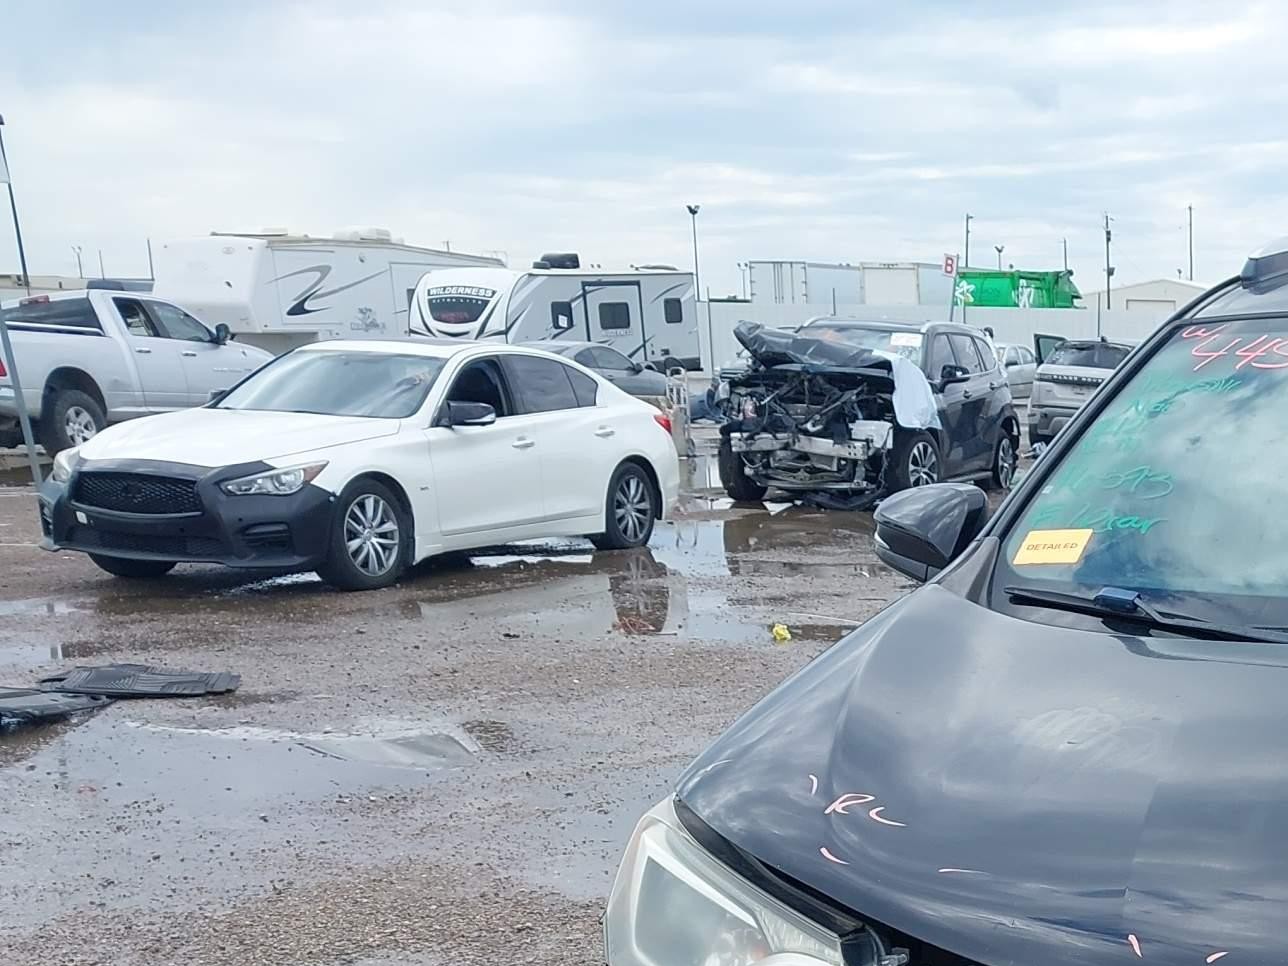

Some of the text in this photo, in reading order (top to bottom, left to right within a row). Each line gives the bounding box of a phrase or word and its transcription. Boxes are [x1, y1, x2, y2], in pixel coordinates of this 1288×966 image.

[944, 256, 954, 274] B
[429, 286, 493, 297] WILDERNESS
[1026, 541, 1079, 552] DETAILED
